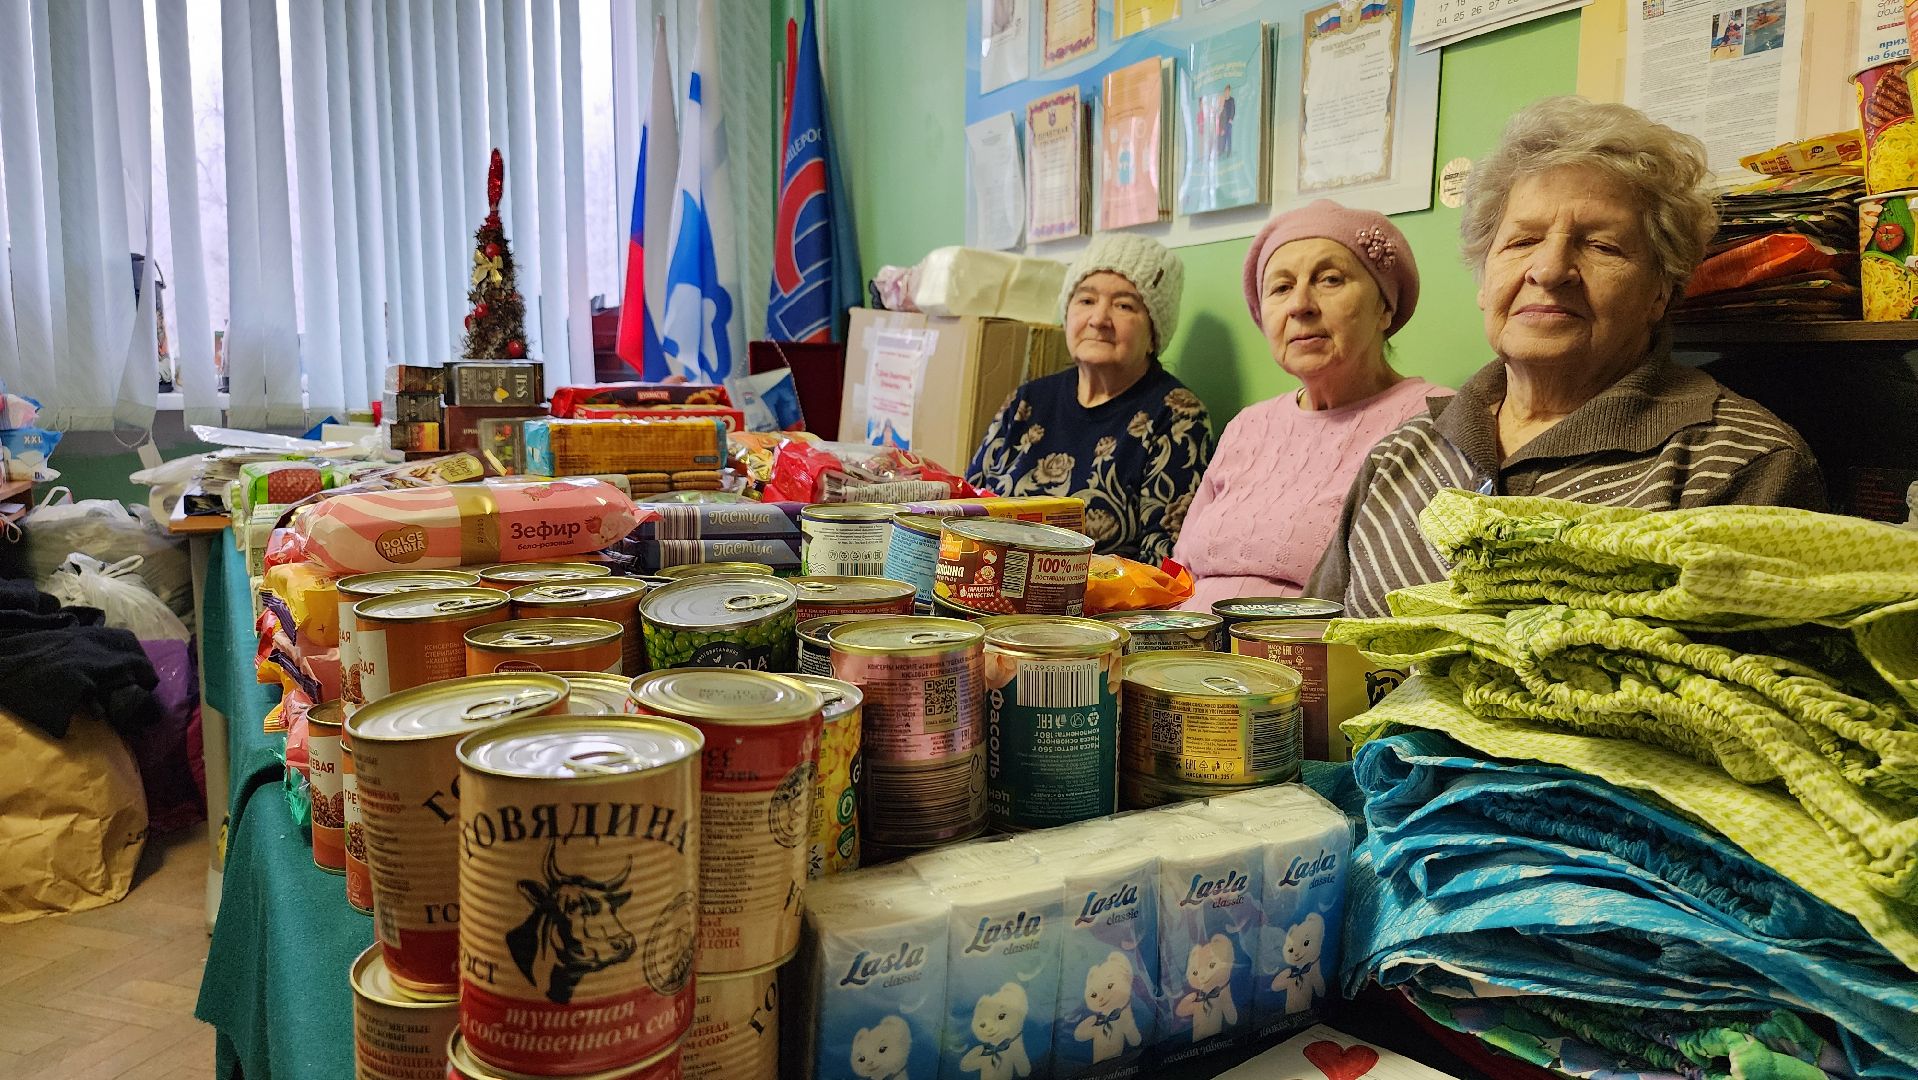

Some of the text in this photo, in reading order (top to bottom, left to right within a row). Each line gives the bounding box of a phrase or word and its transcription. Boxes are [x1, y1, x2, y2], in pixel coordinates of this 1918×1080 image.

[1436, 17, 1447, 26] 24
[1454, 12, 1465, 22] 25
[1471, 6, 1482, 16] 26
[1488, 1, 1500, 10] 27
[709, 511, 770, 525] Пастила
[511, 519, 581, 541] Зефир
[382, 531, 423, 550] DOLCE
[385, 541, 426, 558] MANIA
[713, 543, 773, 557] Пастила
[1037, 557, 1071, 574] 100%
[989, 689, 1005, 779] Фасоль
[1040, 731, 1053, 739] 180
[1079, 736, 1099, 744] Масса
[1079, 743, 1099, 751] Масса
[1278, 849, 1337, 886] Lasla
[1180, 870, 1248, 907] Lasla
[1309, 874, 1335, 890] classic
[1075, 883, 1137, 927] Lasla
[1212, 895, 1245, 908] classic
[1107, 909, 1139, 926] classic
[965, 911, 1041, 954] Lasla
[1003, 939, 1040, 956] classic
[840, 942, 924, 986] Lasla
[883, 970, 922, 988] classic
[505, 1000, 636, 1029] тушеная
[470, 1021, 640, 1052] собственном
